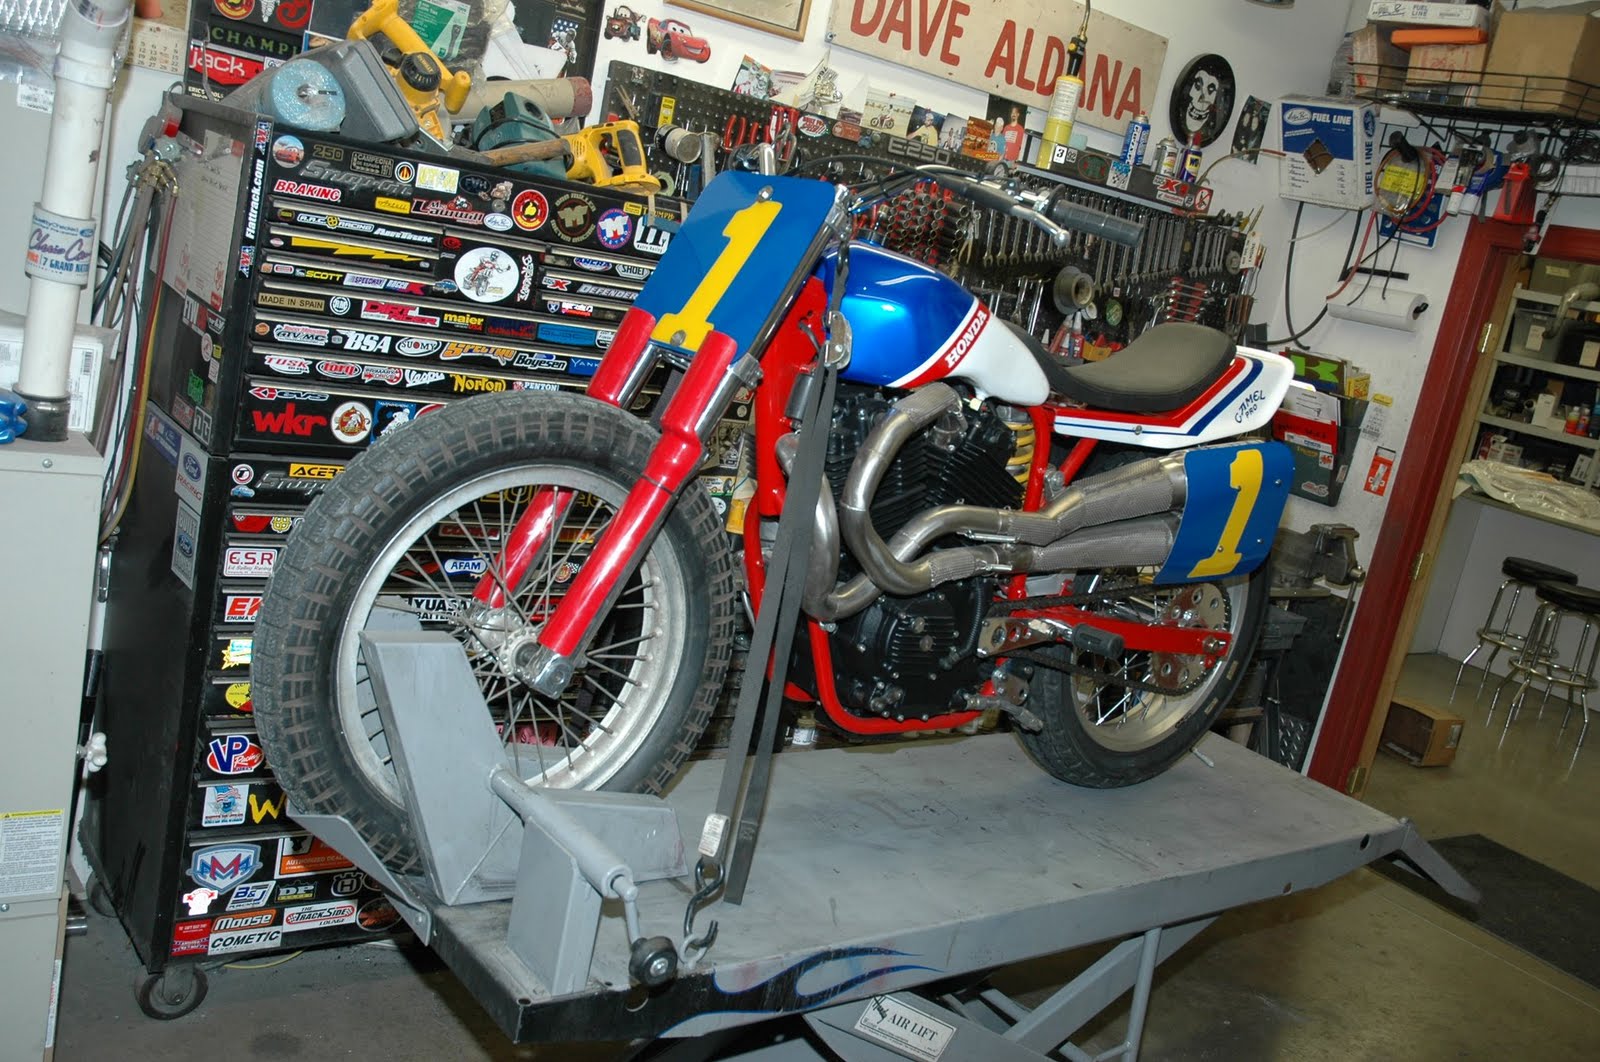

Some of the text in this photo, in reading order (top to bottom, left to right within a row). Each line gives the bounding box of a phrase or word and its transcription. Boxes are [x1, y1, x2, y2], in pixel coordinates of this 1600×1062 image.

[850, 0, 971, 67] DAVE
[1311, 112, 1331, 123] FUEL
[1332, 115, 1352, 125] LINE
[274, 179, 342, 201] BRAKING
[1365, 171, 1373, 195] FUEL
[304, 269, 344, 282] SCOTT
[621, 264, 647, 276] SHOEI
[650, 200, 783, 352] 1
[578, 283, 639, 300] DEFENDER
[260, 295, 285, 306] MADE
[287, 298, 297, 306] IN
[299, 299, 324, 309] SPAIN
[363, 300, 418, 316] DIRT
[444, 313, 484, 327] maier
[344, 333, 392, 354] BSA
[944, 310, 988, 369] HONDA
[265, 356, 313, 369] TUSK
[515, 353, 567, 370] Boyesen
[453, 373, 507, 393] Norton
[523, 381, 559, 392] PENTON
[1234, 390, 1266, 424] CAMEL
[1244, 403, 1259, 419] PRO
[252, 402, 328, 436] wkr
[177, 473, 203, 501] RACING
[1187, 448, 1264, 578] 1
[450, 561, 481, 570] AFAM
[413, 599, 471, 611] YUASA
[209, 735, 250, 773] VP
[213, 912, 272, 932] Moose
[211, 930, 281, 949] COMETIC
[888, 1014, 910, 1030] AIR
[910, 1022, 938, 1041] LIFT
